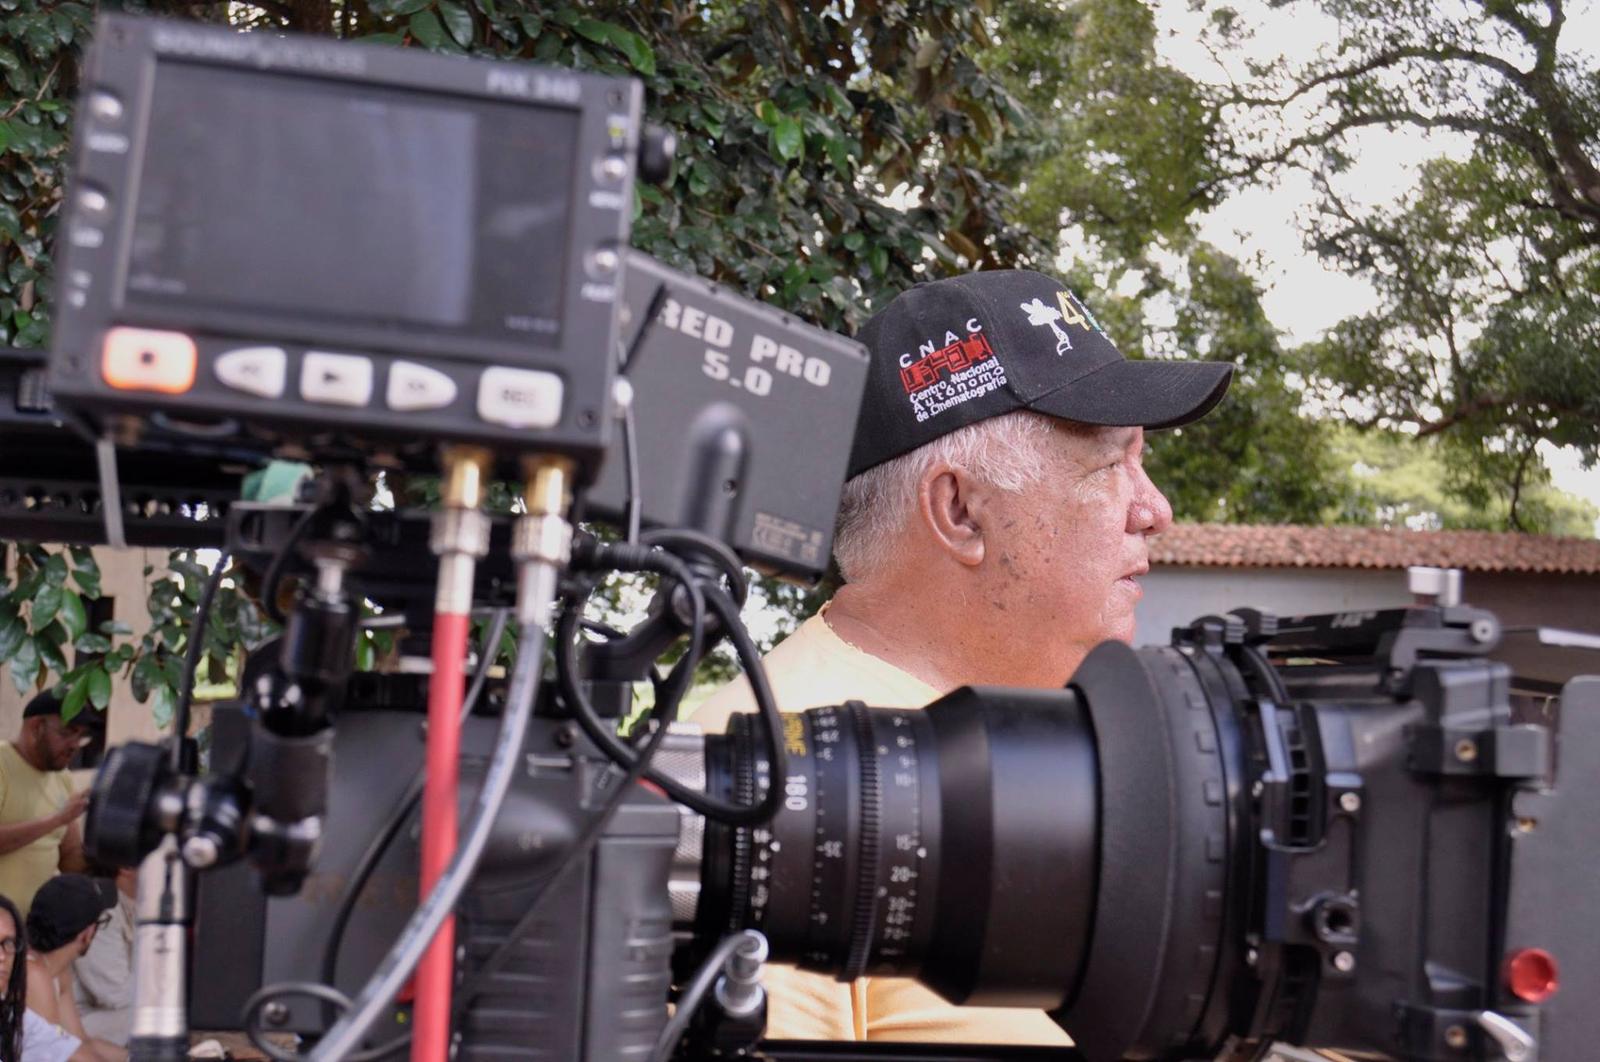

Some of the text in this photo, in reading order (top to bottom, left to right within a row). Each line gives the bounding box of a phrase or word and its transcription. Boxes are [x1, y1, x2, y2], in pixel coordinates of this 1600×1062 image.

[657, 298, 832, 387] RED PRO
[702, 349, 773, 397] 5.0
[910, 355, 1000, 404] Centro Nacional
[916, 411, 929, 422] de
